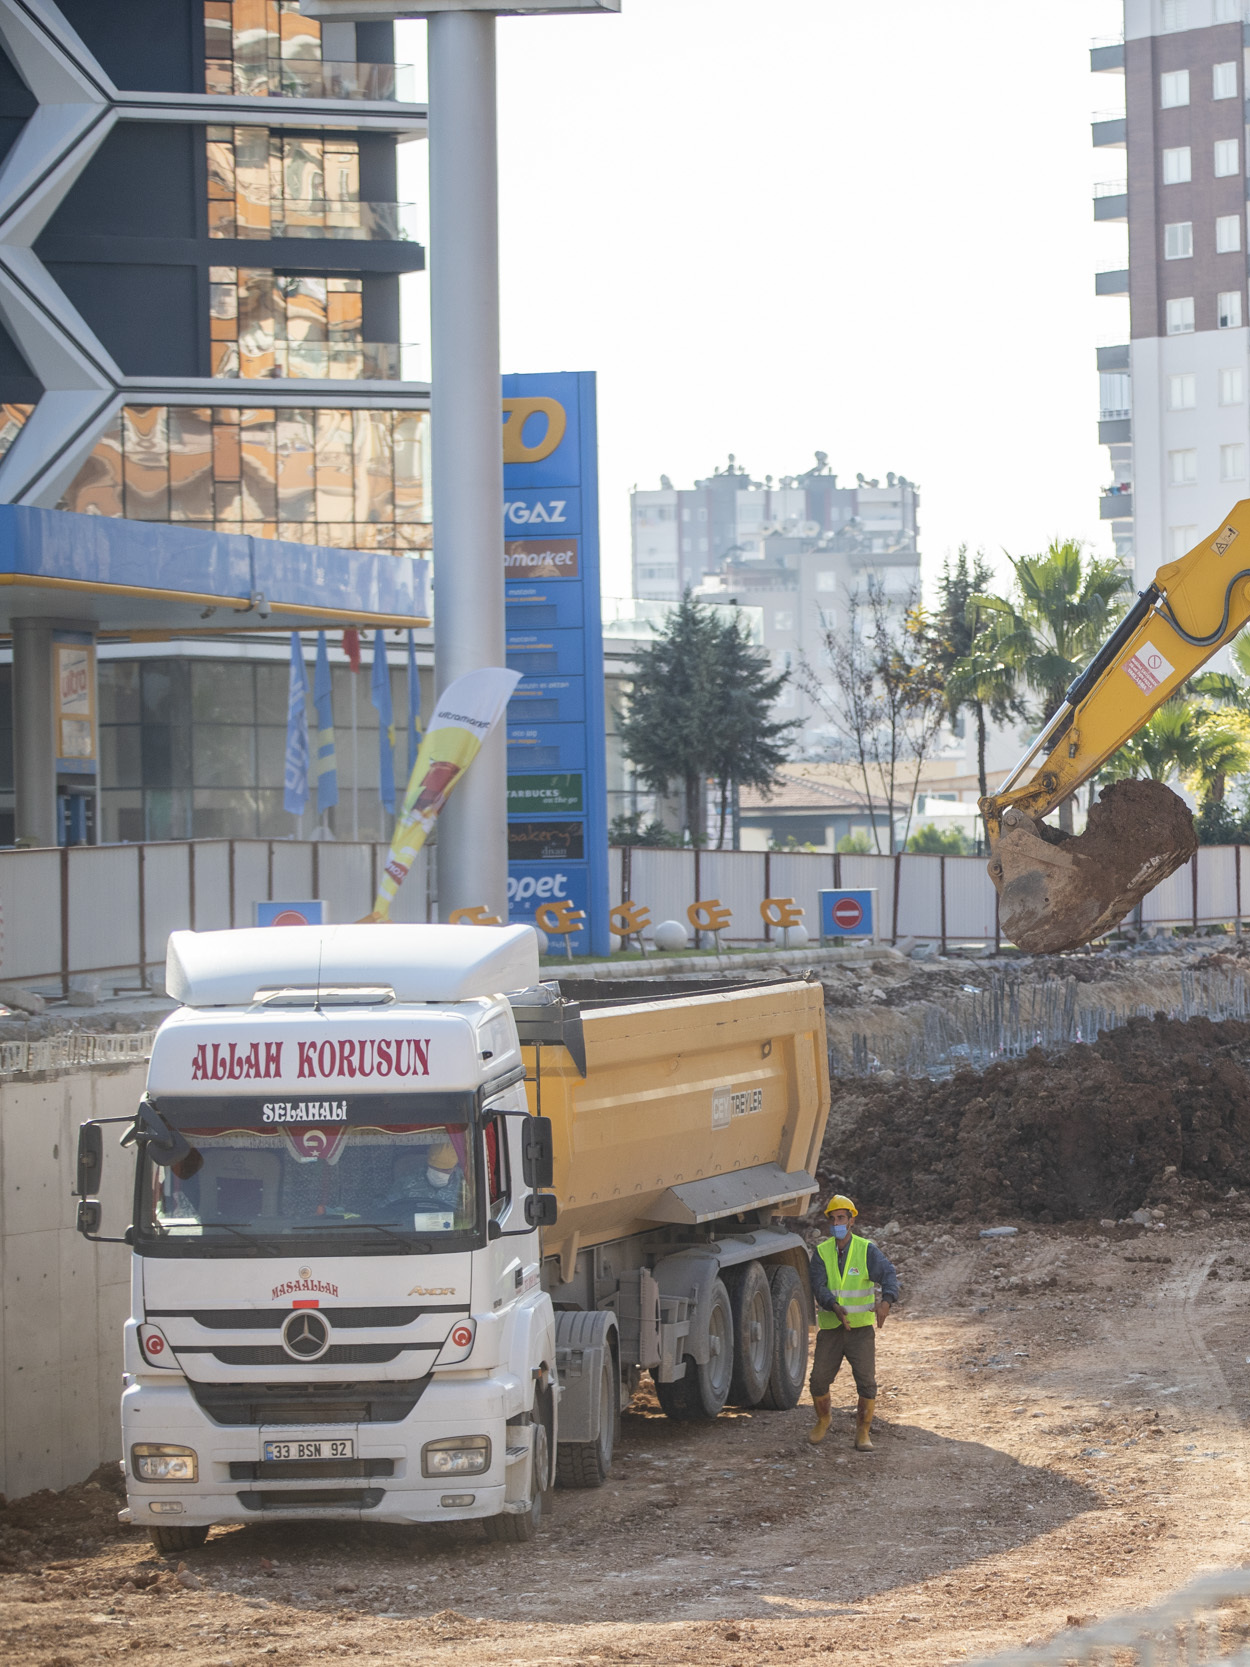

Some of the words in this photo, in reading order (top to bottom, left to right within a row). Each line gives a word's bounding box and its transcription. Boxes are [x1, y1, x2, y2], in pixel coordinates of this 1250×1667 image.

[503, 501, 567, 524] GAZ
[504, 550, 574, 567] amarket
[507, 788, 560, 799] TARBUCKS
[191, 1041, 284, 1080] ALLAH
[297, 1038, 431, 1079] KORUSUN
[274, 1445, 290, 1459] 33
[298, 1443, 321, 1458] BSN
[331, 1442, 347, 1456] 92
